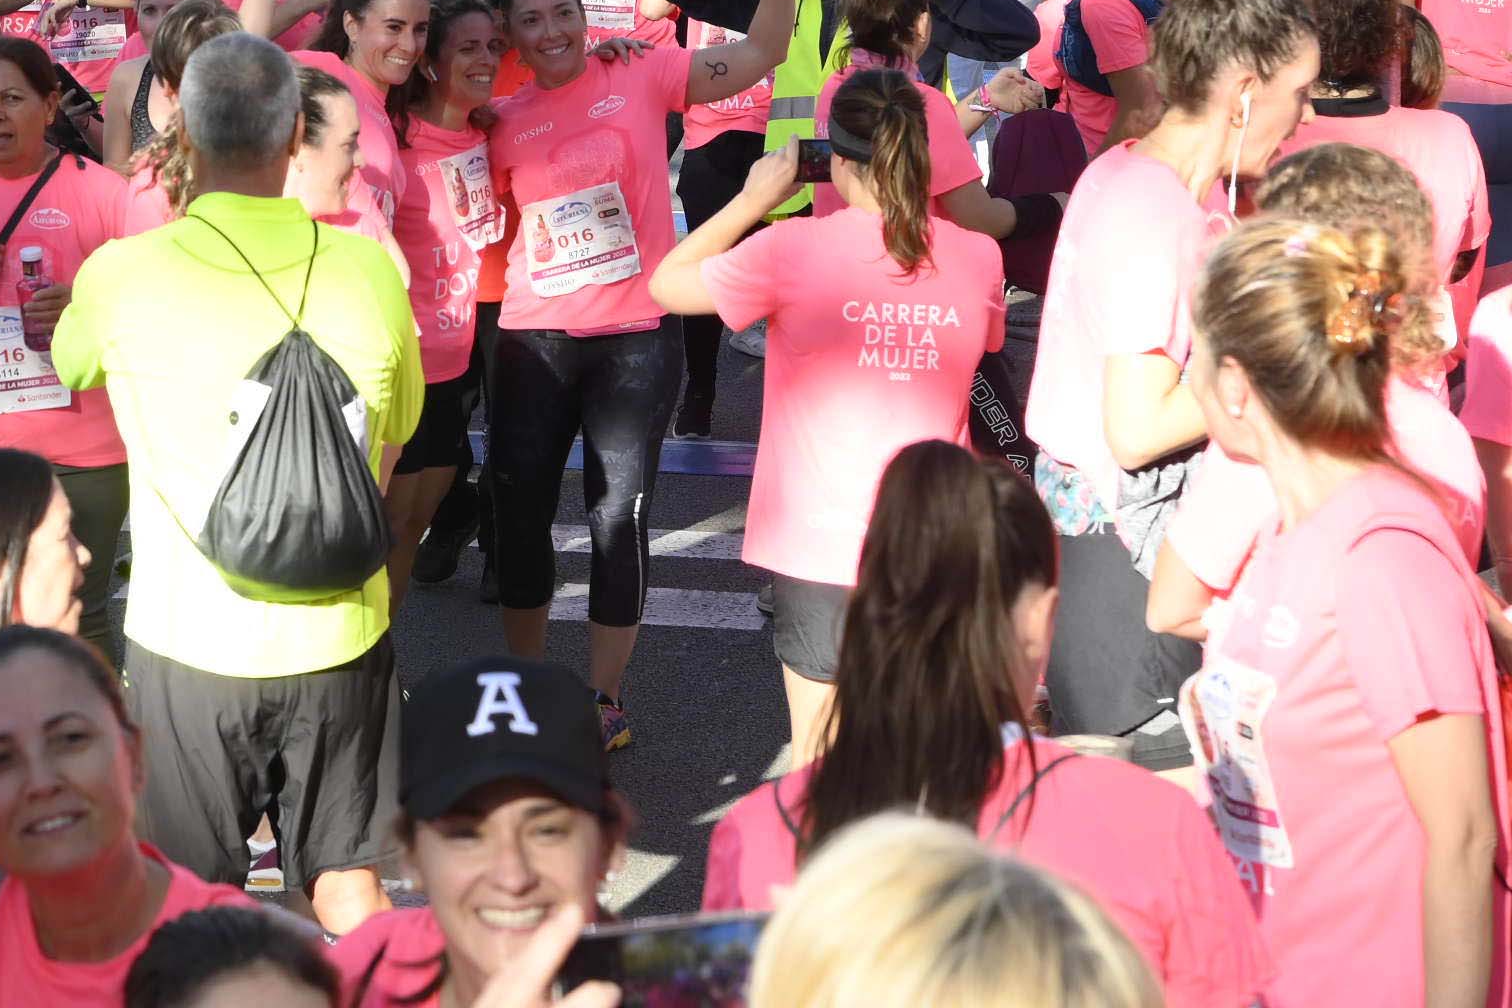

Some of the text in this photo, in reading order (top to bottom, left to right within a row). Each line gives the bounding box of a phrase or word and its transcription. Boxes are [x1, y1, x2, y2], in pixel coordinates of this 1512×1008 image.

[73, 17, 98, 29] 016
[514, 121, 554, 145] OYSHO
[557, 228, 594, 249] 016
[432, 241, 460, 269] TU
[568, 247, 590, 260] 8727
[434, 268, 479, 301] DOR
[842, 300, 961, 328] CARRERA
[864, 324, 937, 347] DE LA
[857, 347, 940, 370] MUJER
[7, 382, 17, 390] LA
[17, 379, 40, 389] MUJER
[26, 391, 63, 403] Santander
[465, 669, 540, 737] A
